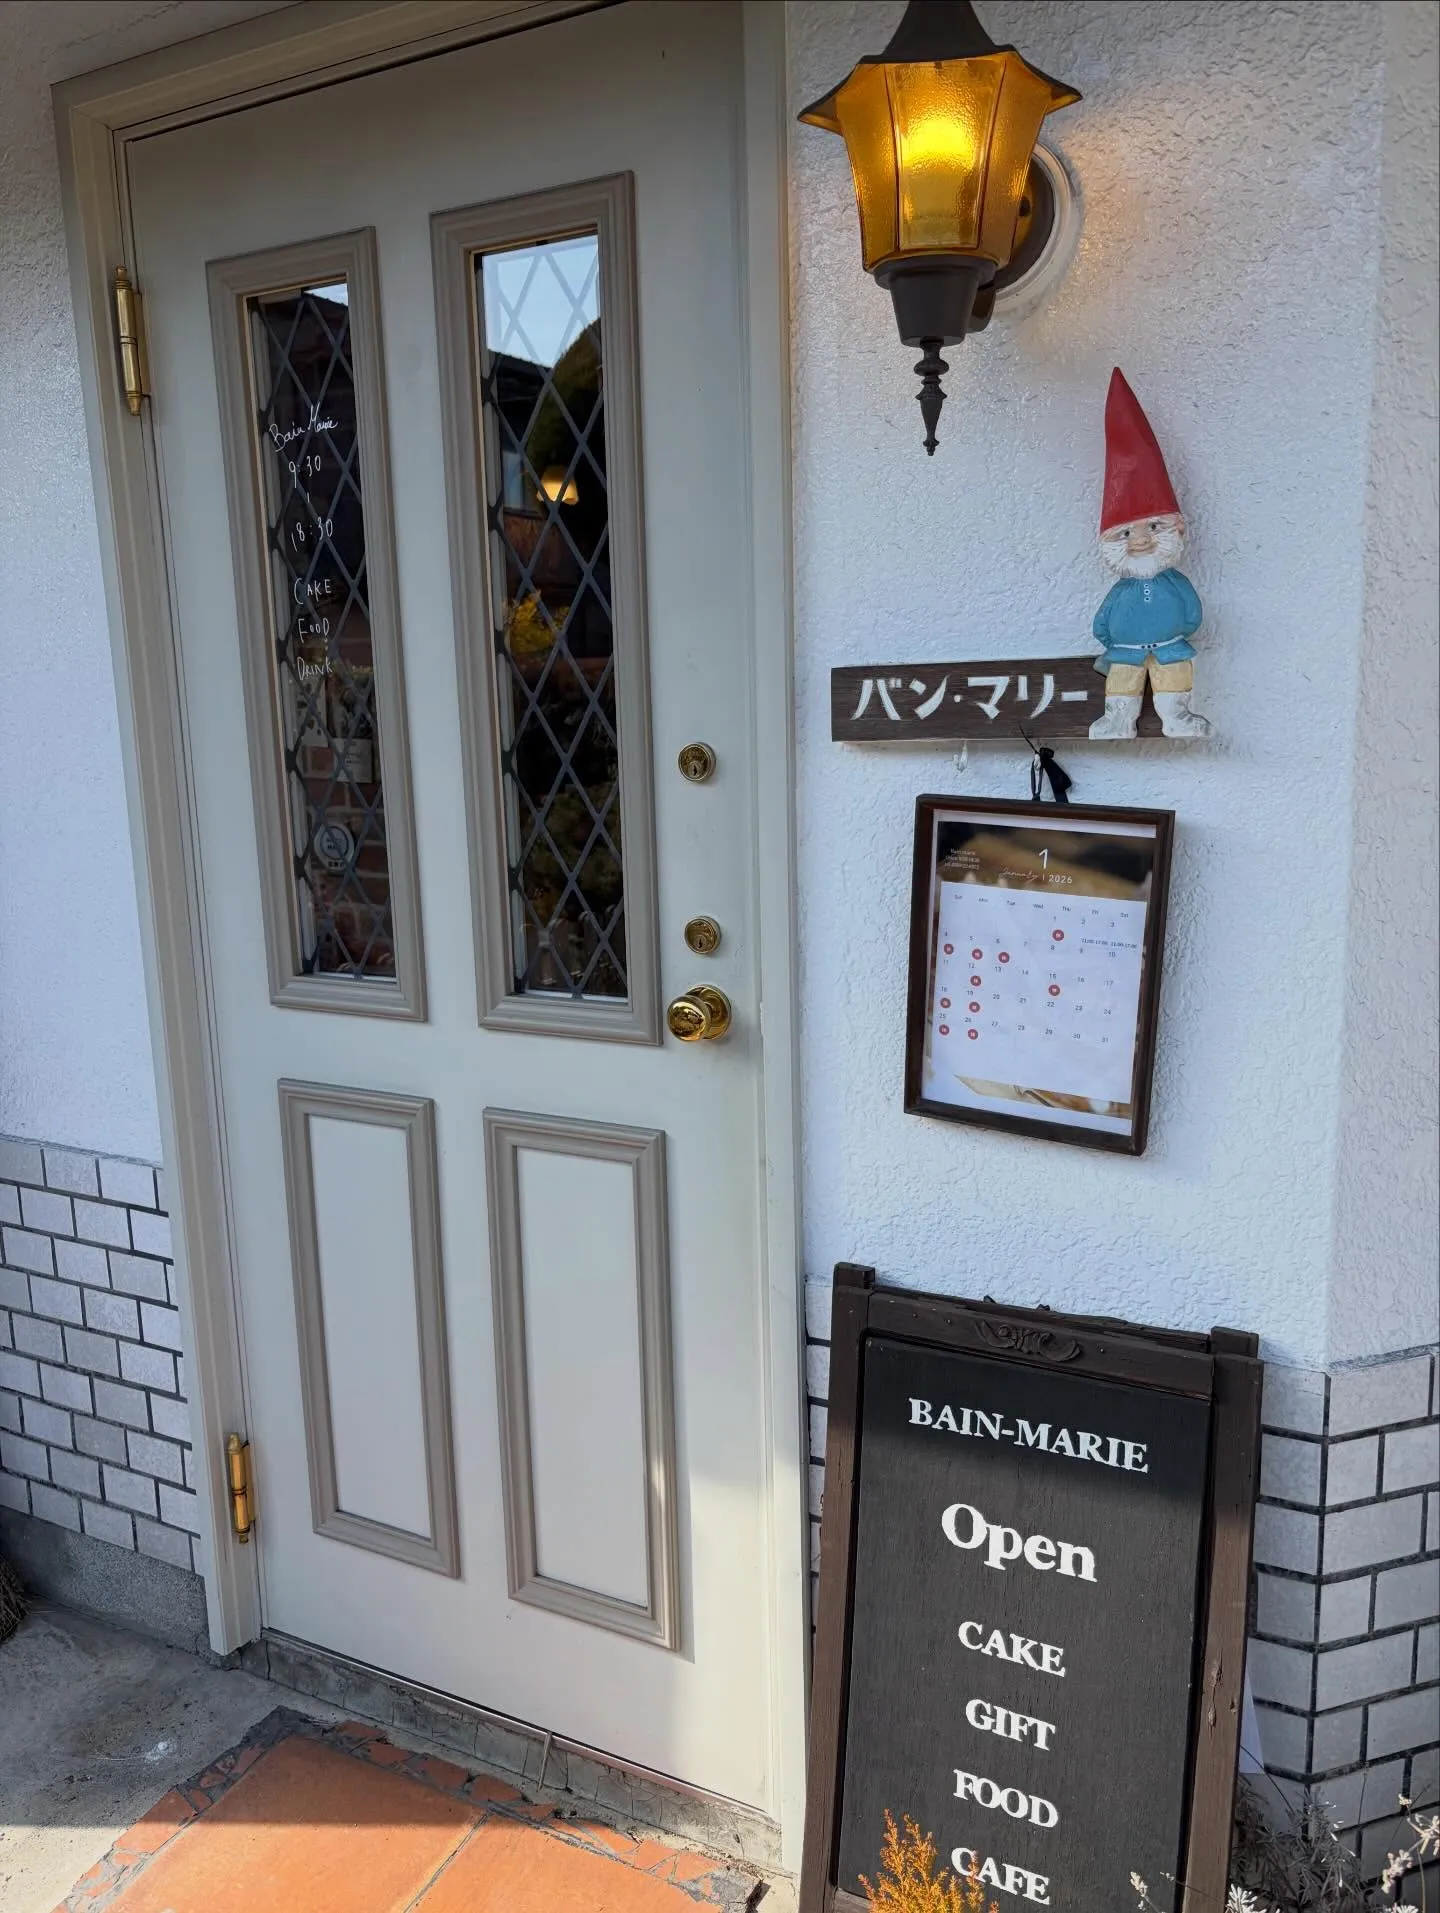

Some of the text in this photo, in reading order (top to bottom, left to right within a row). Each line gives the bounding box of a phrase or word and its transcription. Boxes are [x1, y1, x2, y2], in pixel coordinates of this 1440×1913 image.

[288, 455, 321, 489] 9:30
[291, 516, 333, 552] 18:30
[293, 578, 332, 605] CAKE
[298, 618, 330, 644] FOOD
[1038, 848, 1048, 870] 1
[1049, 874, 1073, 884] 2026
[908, 1397, 1149, 1474] BAIN-MARIE
[941, 1503, 1097, 1583] Open
[958, 1621, 1066, 1677] CAKE
[965, 1699, 1056, 1751] GIFT
[953, 1768, 1059, 1828] FOOD
[951, 1847, 1050, 1906] CAFE
